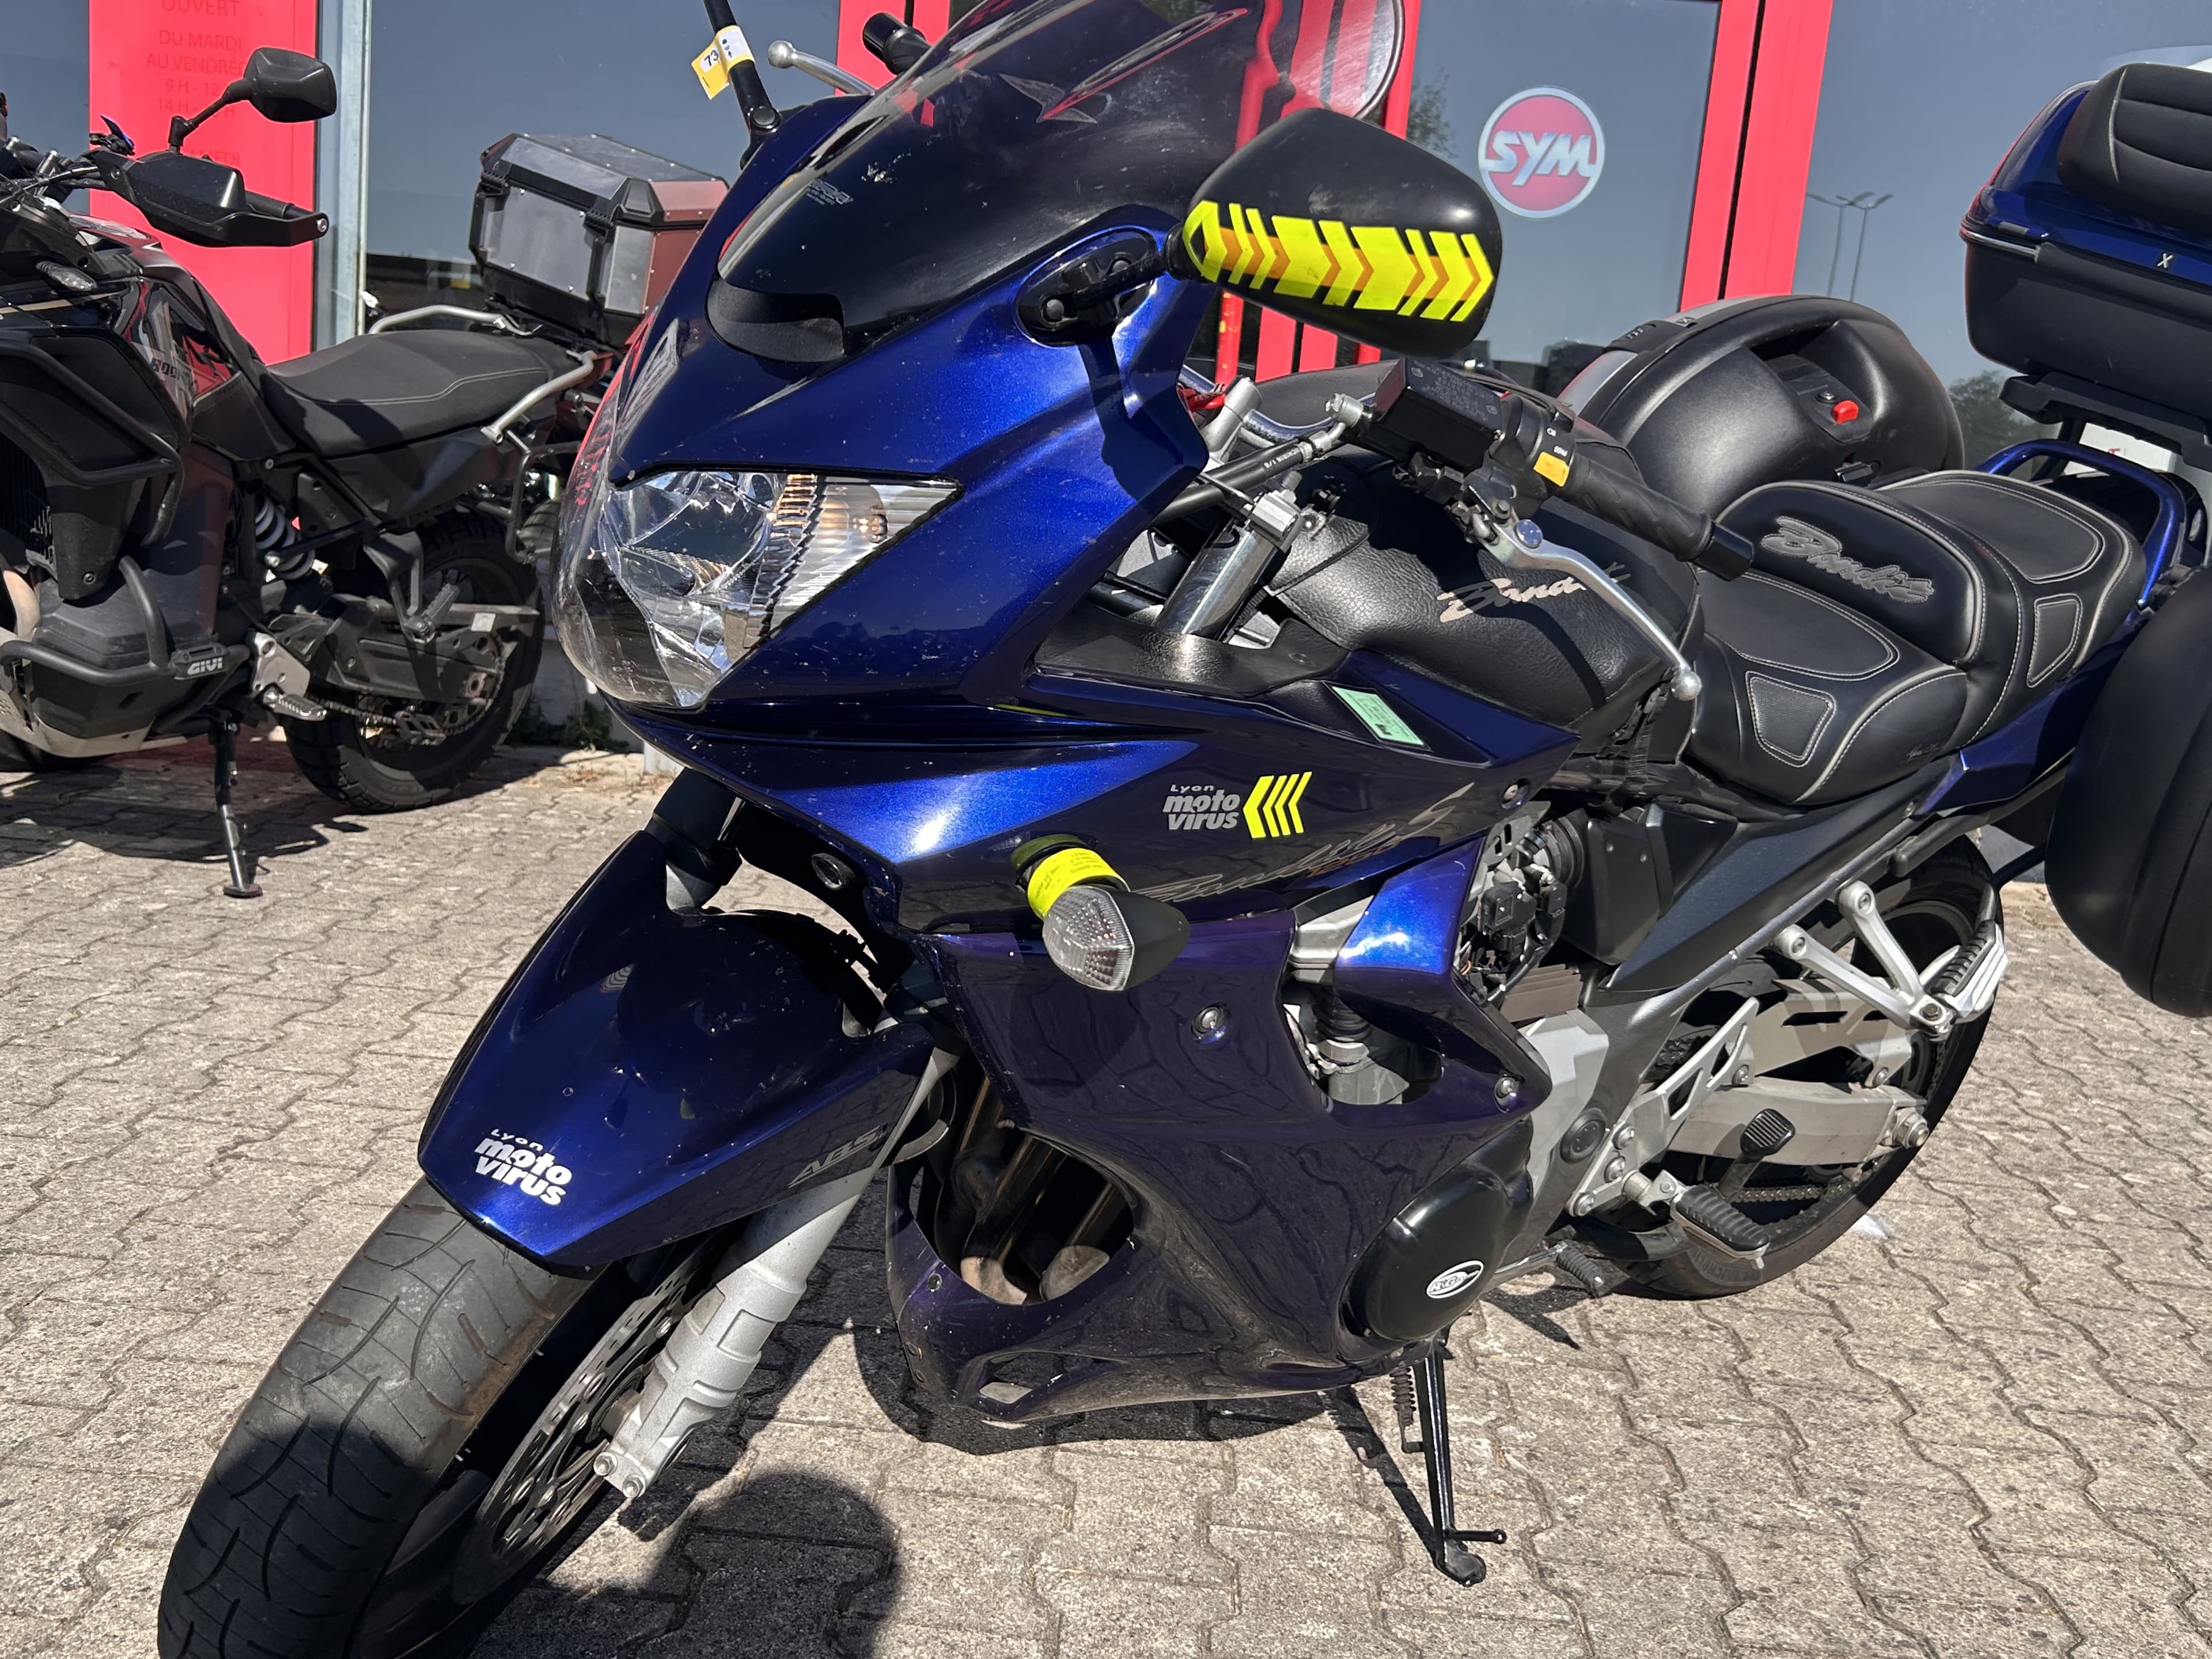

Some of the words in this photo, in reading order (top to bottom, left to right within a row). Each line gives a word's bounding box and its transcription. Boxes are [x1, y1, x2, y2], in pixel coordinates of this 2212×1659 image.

[162, 0, 241, 17] OUVERT
[159, 29, 183, 46] DU
[188, 33, 242, 51] MARDI
[146, 53, 169, 69] AU
[704, 50, 719, 67] 73
[1483, 130, 1597, 187] SYM
[187, 657, 223, 675] GIVI
[1170, 784, 1214, 794] Lyon
[1162, 789, 1240, 813] moto
[1168, 812, 1239, 830] virus
[491, 1128, 543, 1151] Lyon
[474, 1138, 572, 1185] moto
[787, 1125, 881, 1189] ABS
[475, 1156, 566, 1205] virus
